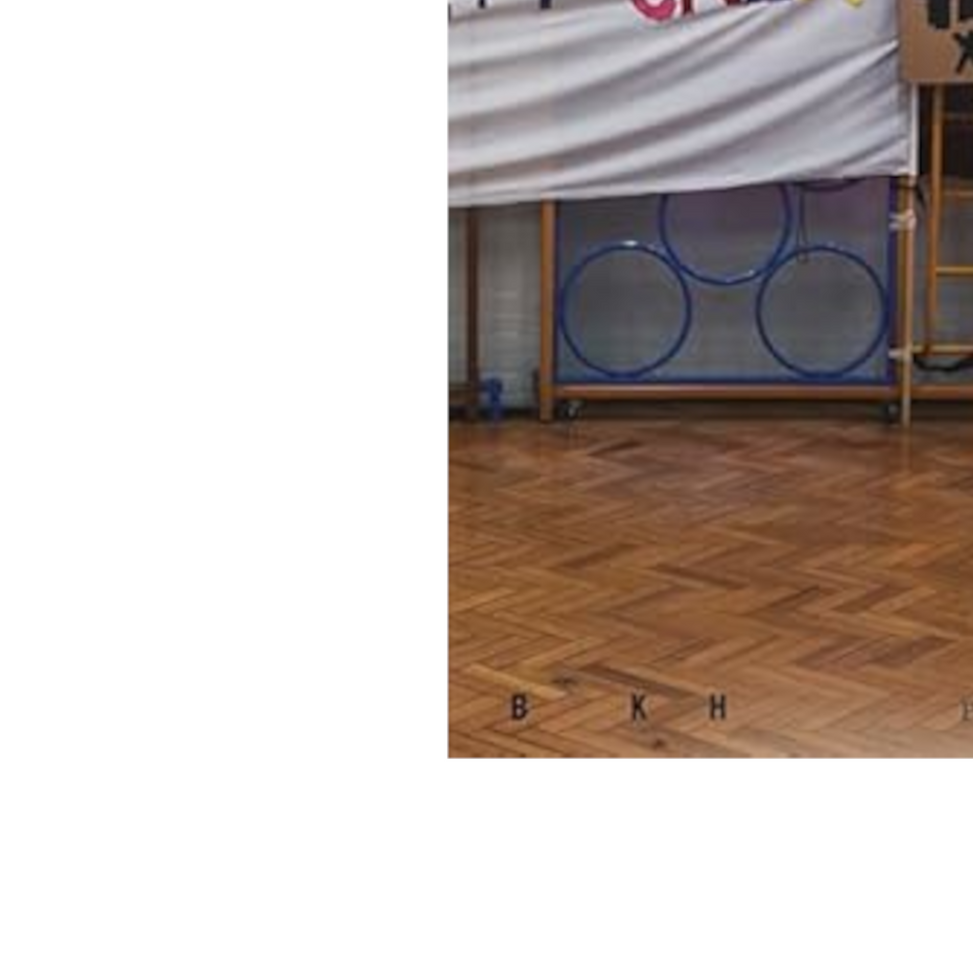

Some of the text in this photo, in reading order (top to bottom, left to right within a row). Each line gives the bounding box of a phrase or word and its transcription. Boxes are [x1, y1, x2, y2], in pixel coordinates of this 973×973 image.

[510, 692, 727, 721] B K H
